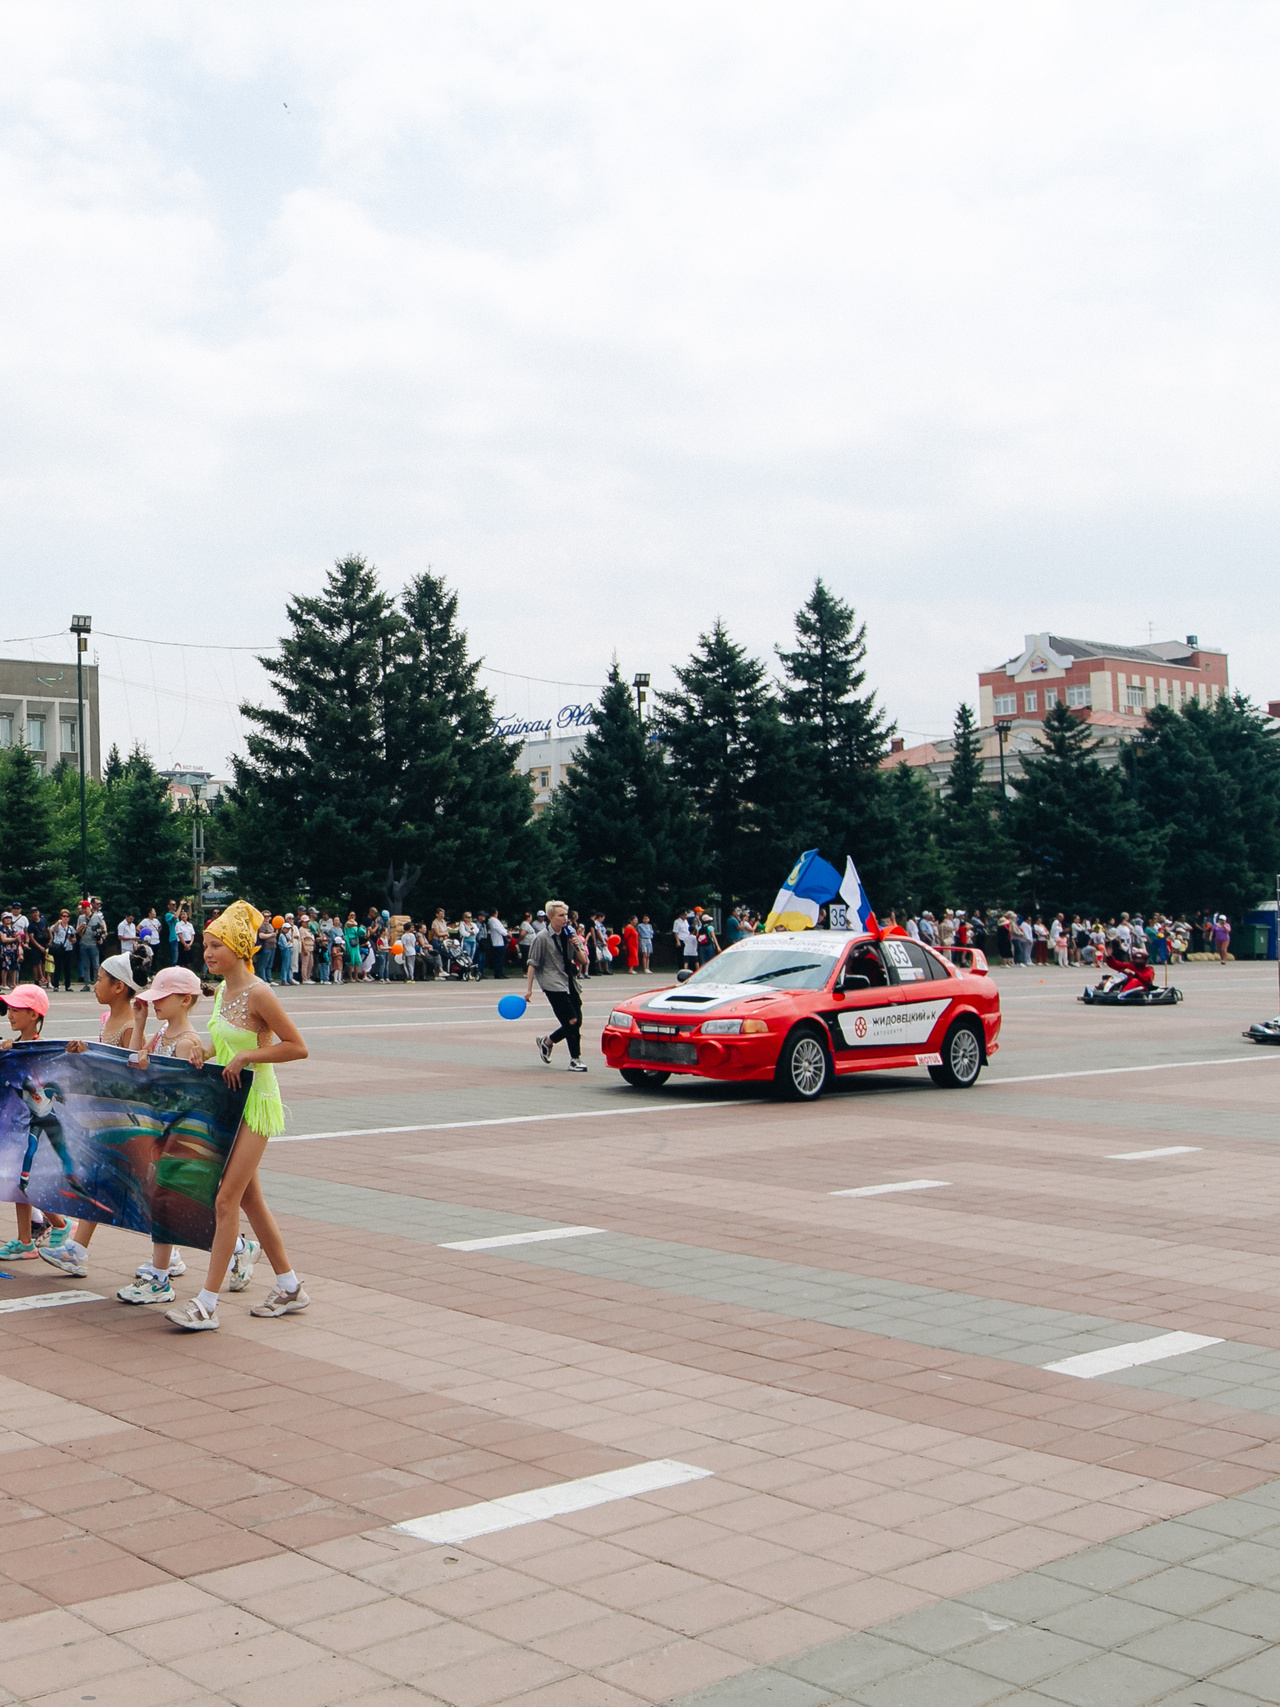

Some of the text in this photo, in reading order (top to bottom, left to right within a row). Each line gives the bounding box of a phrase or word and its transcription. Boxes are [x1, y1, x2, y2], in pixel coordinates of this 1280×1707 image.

[488, 713, 552, 738] Байкал
[831, 908, 846, 927] 35
[888, 944, 909, 965] 35
[872, 1009, 926, 1026] ЖИДОВЕЦКИЙ
[931, 1011, 937, 1020] К
[873, 1028, 903, 1036] АВТОЦЕНТР
[918, 1055, 940, 1065] MOTUL
